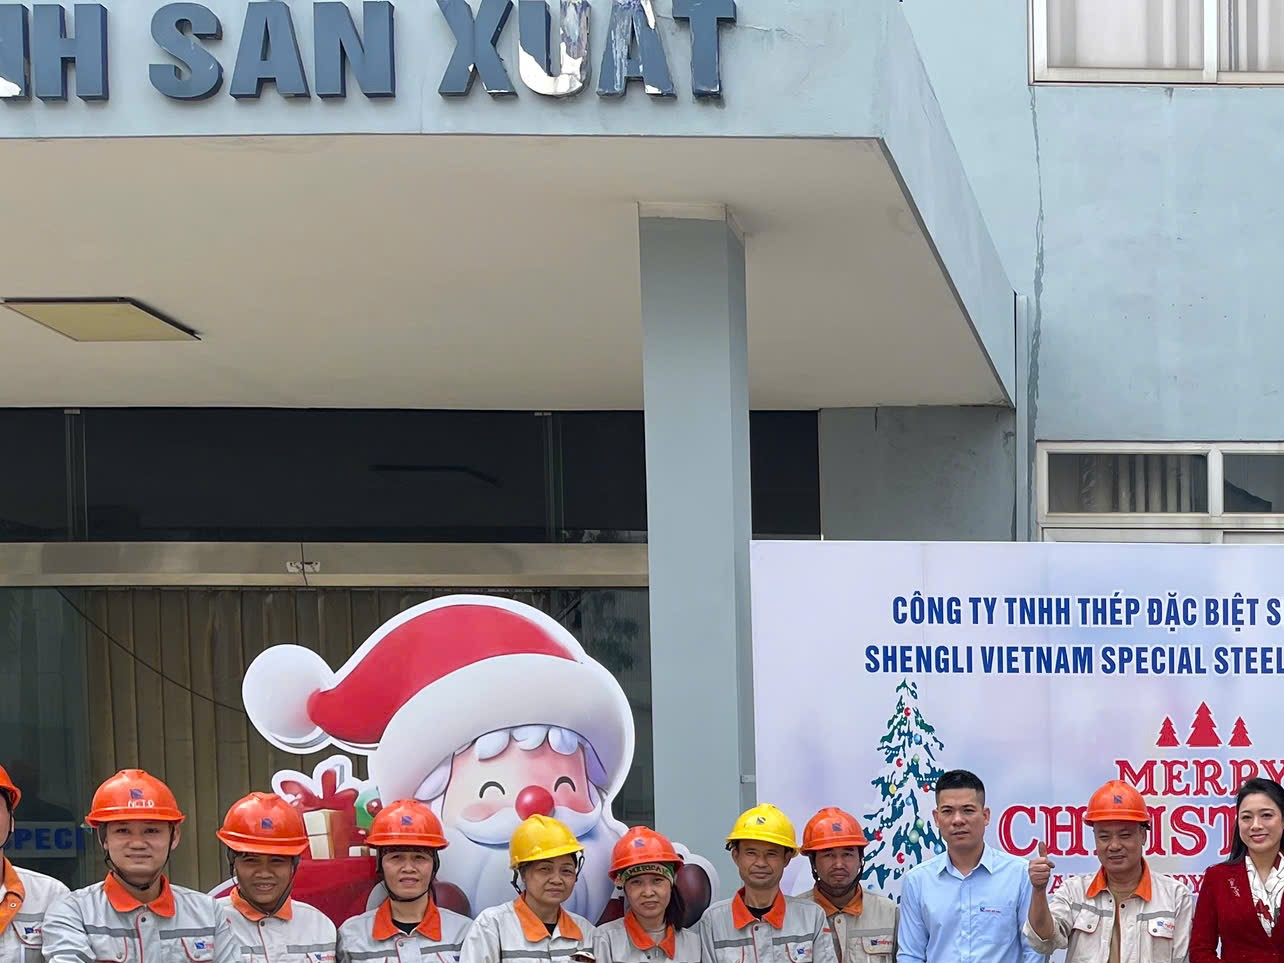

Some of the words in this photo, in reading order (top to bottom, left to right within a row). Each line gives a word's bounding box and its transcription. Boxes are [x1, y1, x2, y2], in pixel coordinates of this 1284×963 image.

[892, 591, 962, 625] CÔNG
[969, 596, 997, 625] TY
[1005, 597, 1071, 625] TNHH
[1078, 592, 1140, 625] THÉP
[1147, 592, 1198, 632] ĐẶC
[1205, 592, 1259, 632] BIỆT
[865, 645, 973, 674] SHENGLI
[980, 646, 1093, 674] VIETNAM
[1101, 646, 1207, 675] SPECIAL
